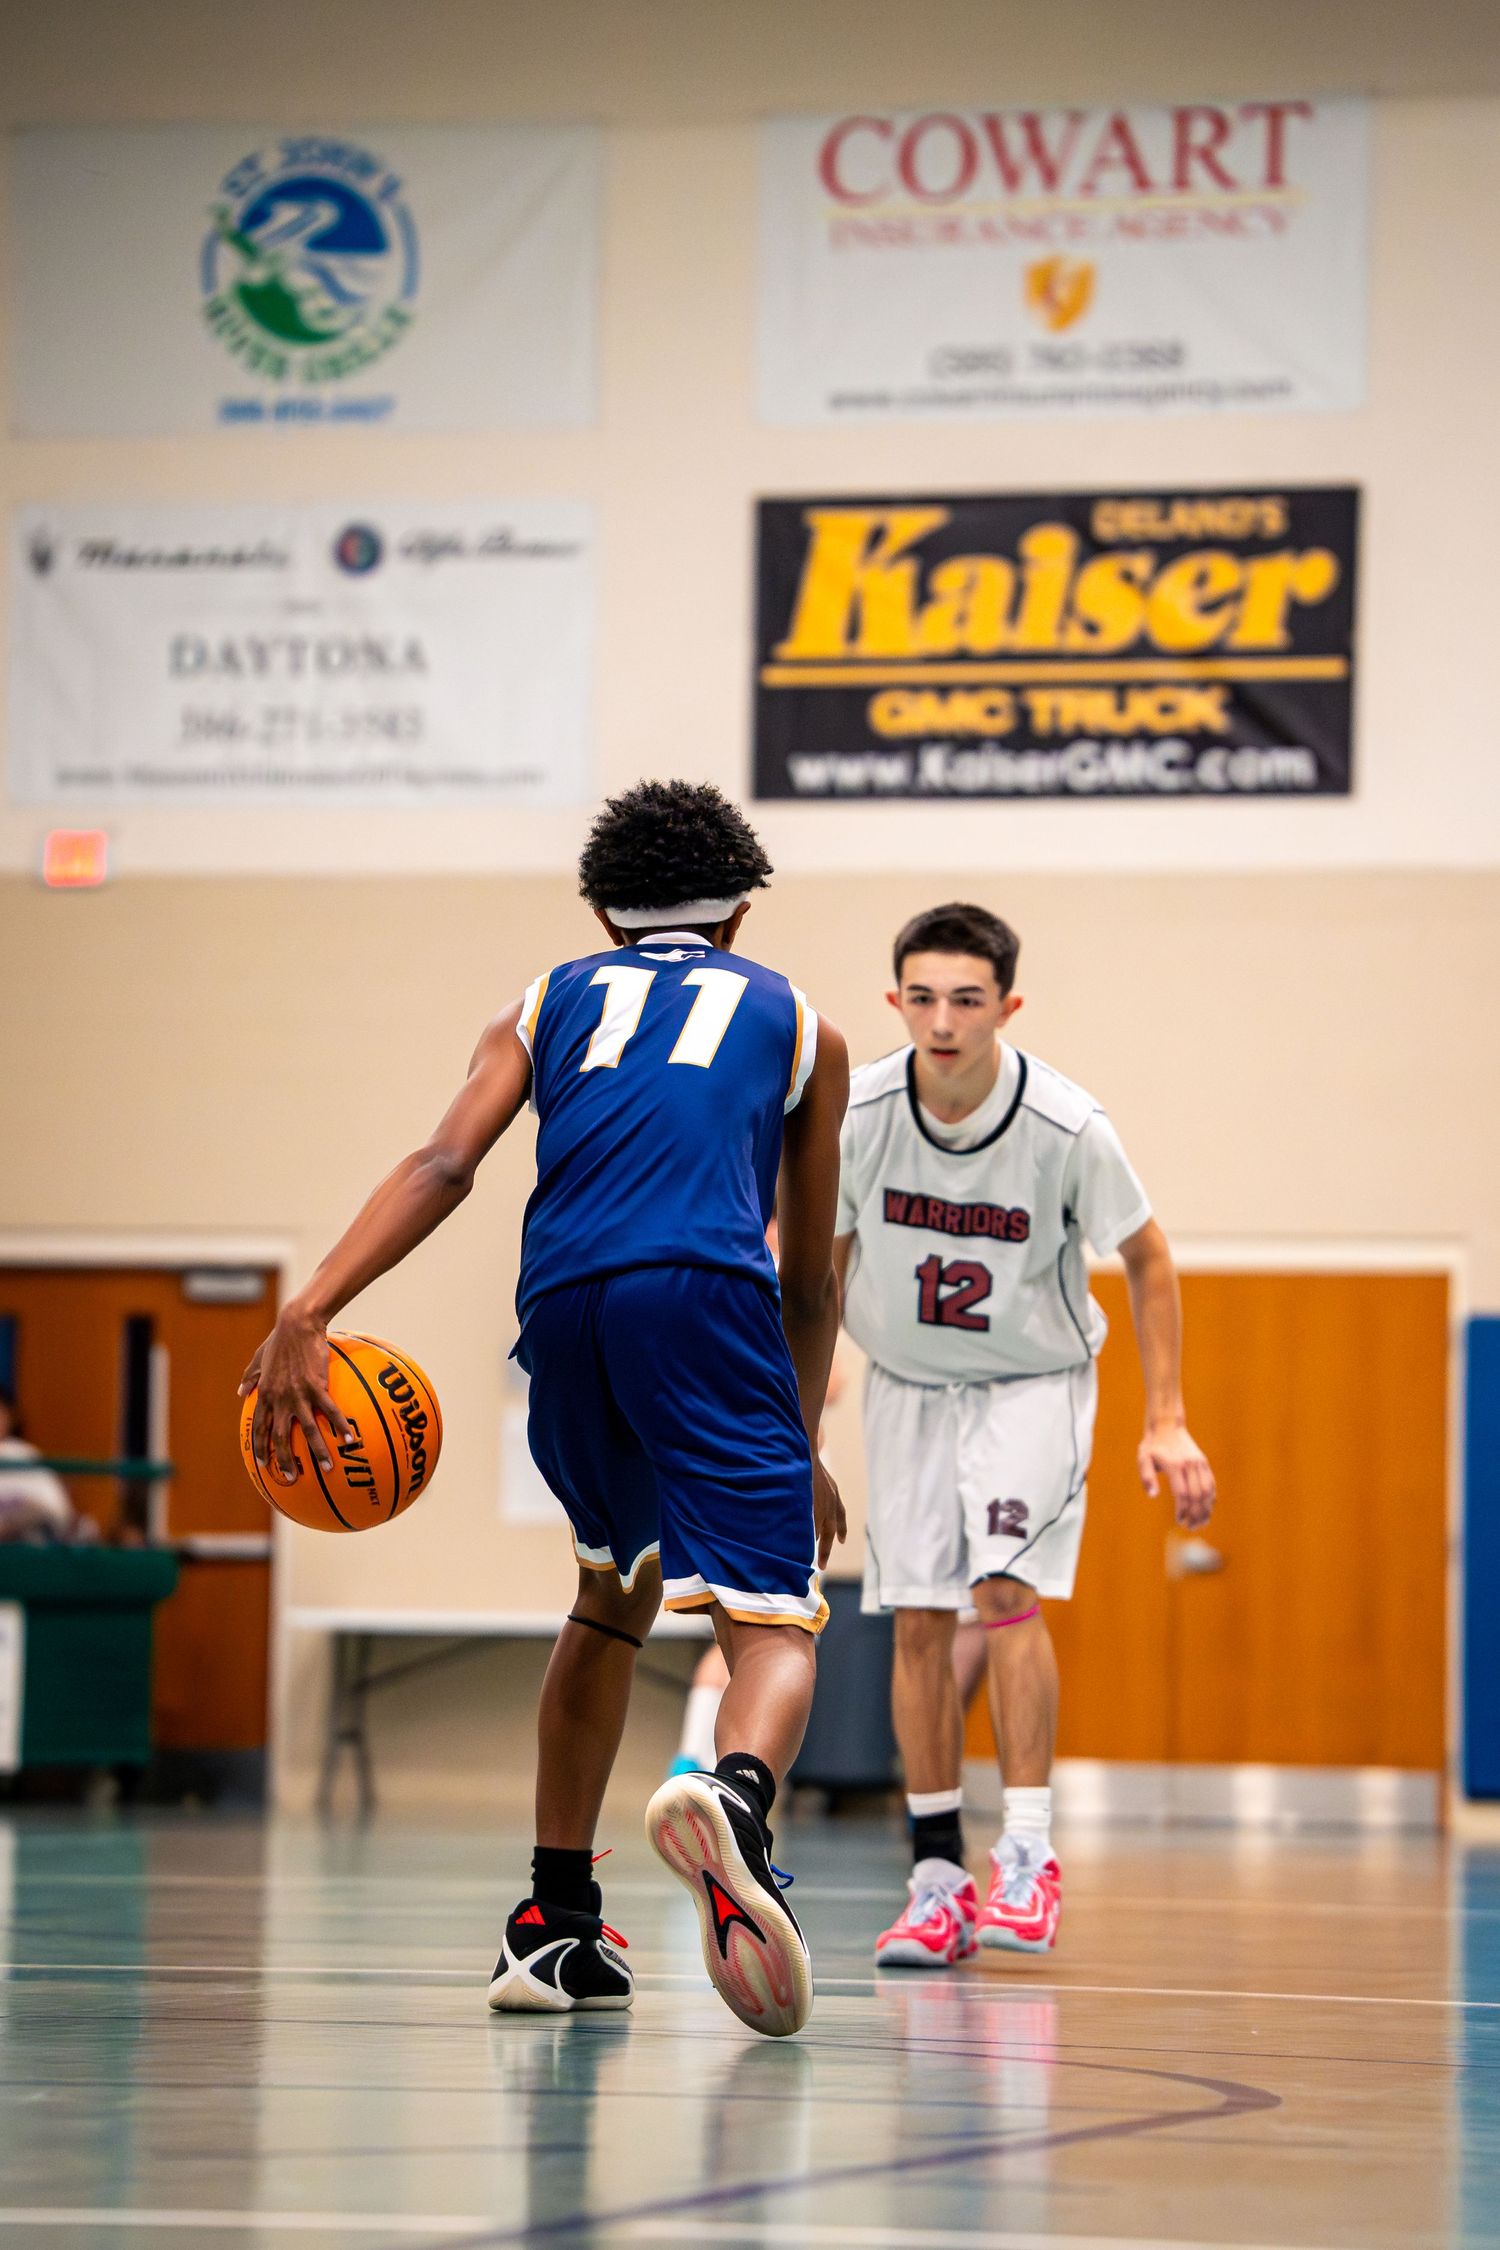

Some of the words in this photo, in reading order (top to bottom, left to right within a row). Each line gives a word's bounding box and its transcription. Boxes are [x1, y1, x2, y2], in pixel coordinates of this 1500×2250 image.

[817, 101, 1312, 207] COWART
[771, 506, 1337, 659] Kaiser
[167, 635, 427, 679] DAYTONA
[867, 689, 1014, 736] GMC
[1022, 686, 1230, 734] TRUCK
[787, 739, 1316, 792] www.KaiserGMC.com
[579, 965, 749, 1072] 11
[883, 1187, 1030, 1243] WARRIORS
[914, 1253, 993, 1333] 12
[377, 1361, 428, 1498] Wilson
[987, 1498, 1029, 1539] 12
